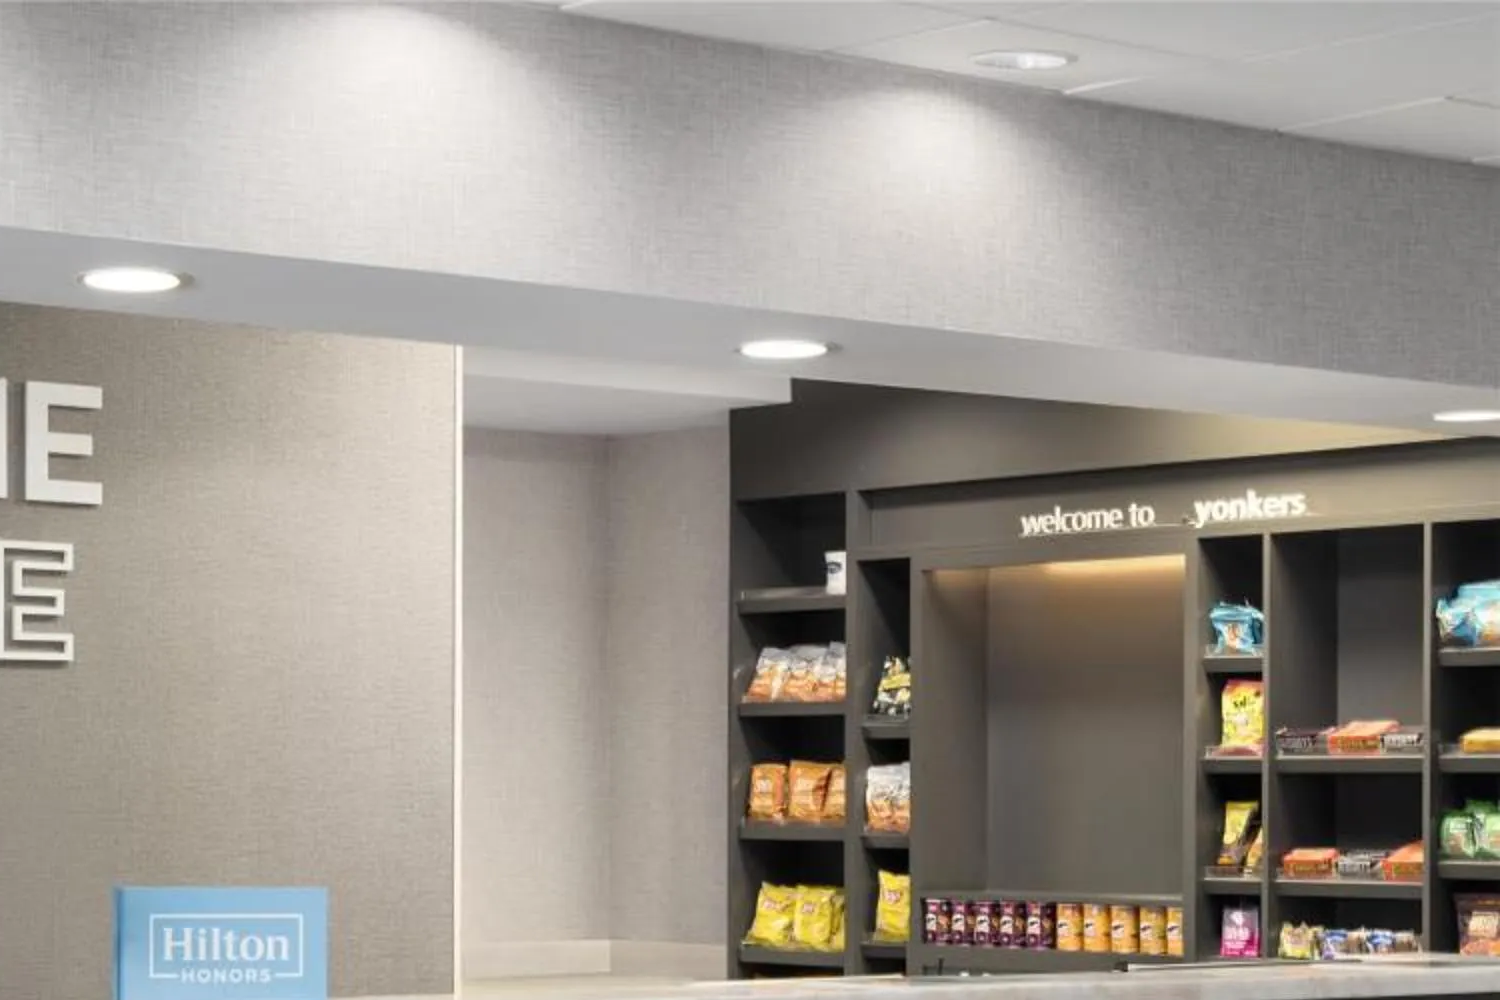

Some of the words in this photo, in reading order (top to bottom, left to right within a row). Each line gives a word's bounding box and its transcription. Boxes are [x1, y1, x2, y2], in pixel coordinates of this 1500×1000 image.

[1019, 505, 1124, 536] welcome
[1127, 502, 1156, 528] to
[1192, 488, 1307, 528] yonkers
[162, 927, 290, 962] Hilton
[180, 967, 273, 985] HONORS
